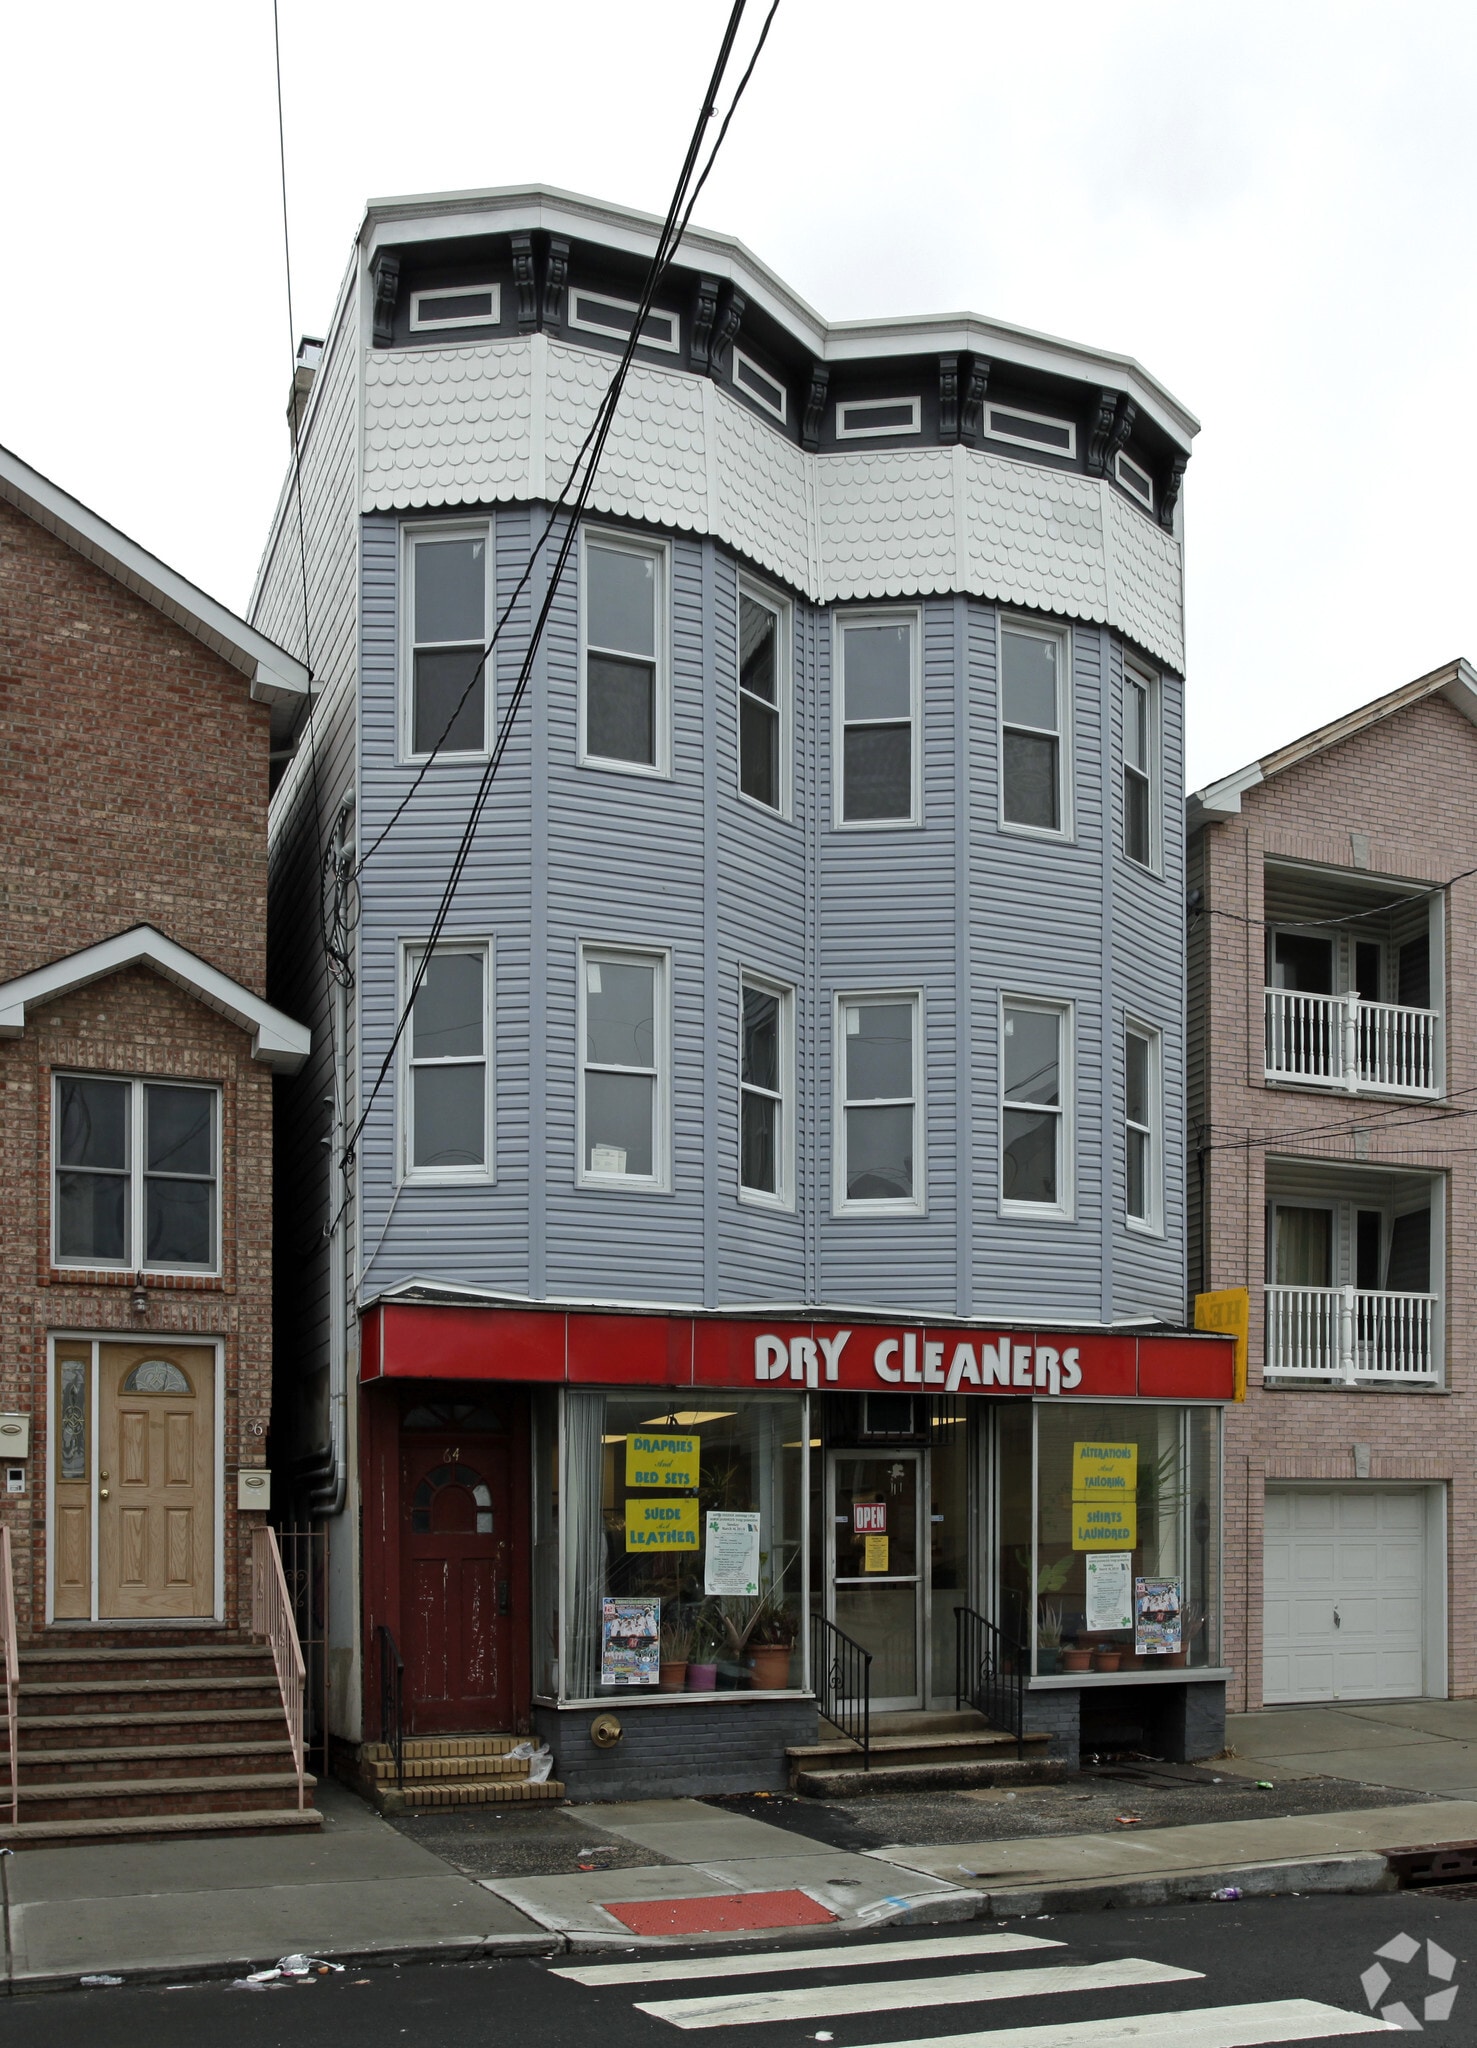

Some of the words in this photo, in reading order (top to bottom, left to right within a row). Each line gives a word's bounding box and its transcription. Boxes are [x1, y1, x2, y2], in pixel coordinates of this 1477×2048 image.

[755, 1330, 852, 1388] DRY
[874, 1332, 1082, 1395] CLEANERS
[634, 1438, 693, 1454] DRAPRIES
[1080, 1447, 1132, 1459] ALTERATIONS
[443, 1447, 460, 1463] 64
[635, 1471, 659, 1484] BED
[664, 1472, 690, 1485] SETS
[1084, 1476, 1125, 1488] TAILORING
[644, 1507, 681, 1520] SUEDE
[856, 1506, 884, 1529] OPEN
[1087, 1510, 1123, 1524] SHIRTS
[630, 1529, 696, 1545] LEATHER
[1078, 1526, 1130, 1541] LAUNDRED
